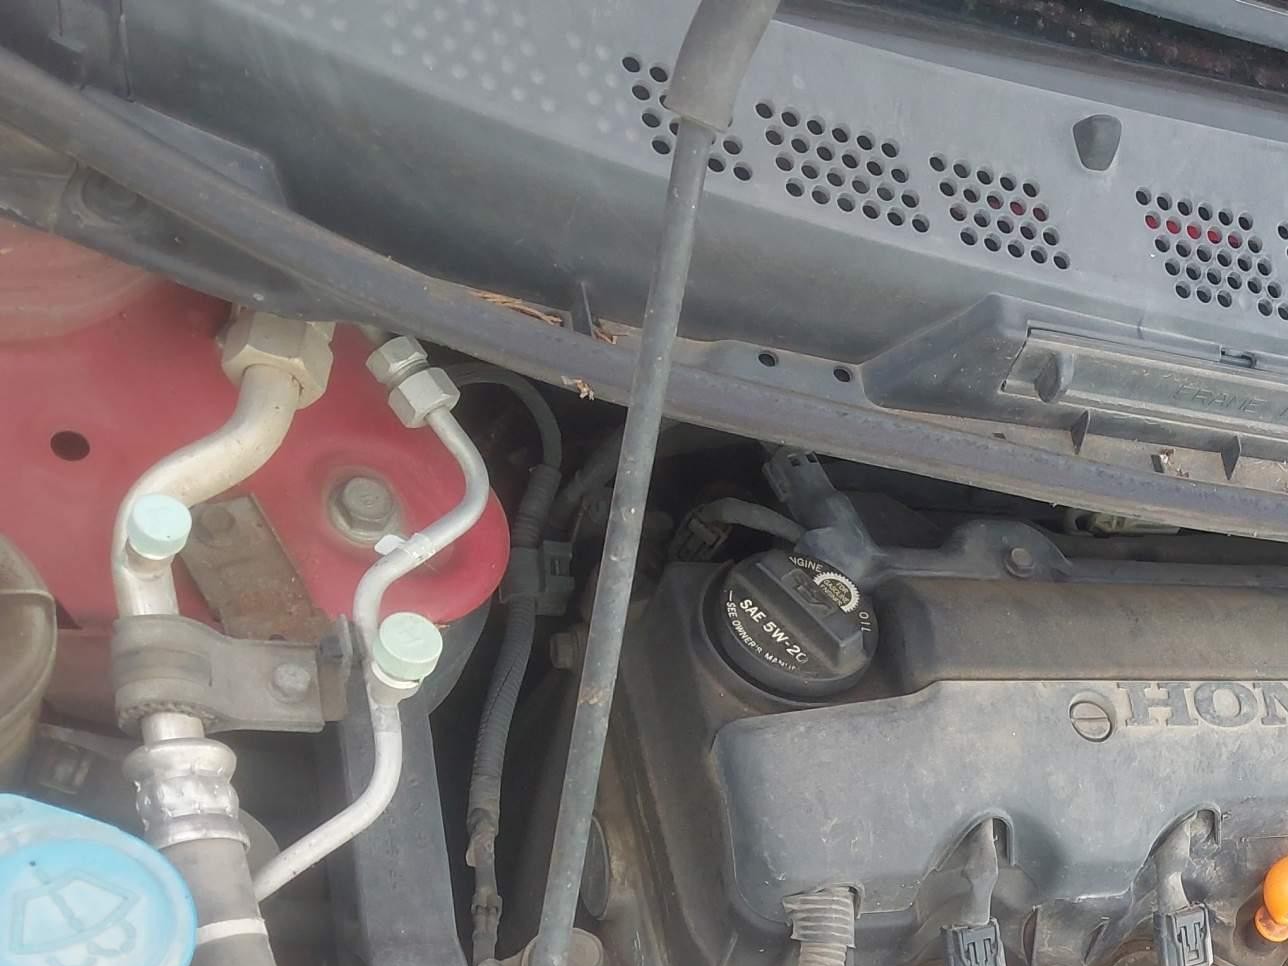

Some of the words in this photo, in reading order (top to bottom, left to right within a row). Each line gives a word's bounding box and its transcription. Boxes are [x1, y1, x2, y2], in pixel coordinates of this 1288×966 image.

[1172, 382, 1265, 412] FRAME
[789, 556, 824, 572] NGINE
[859, 611, 872, 632] OIL
[739, 599, 767, 622] SAE
[762, 620, 809, 664] 5W-20
[764, 652, 797, 670] MAN
